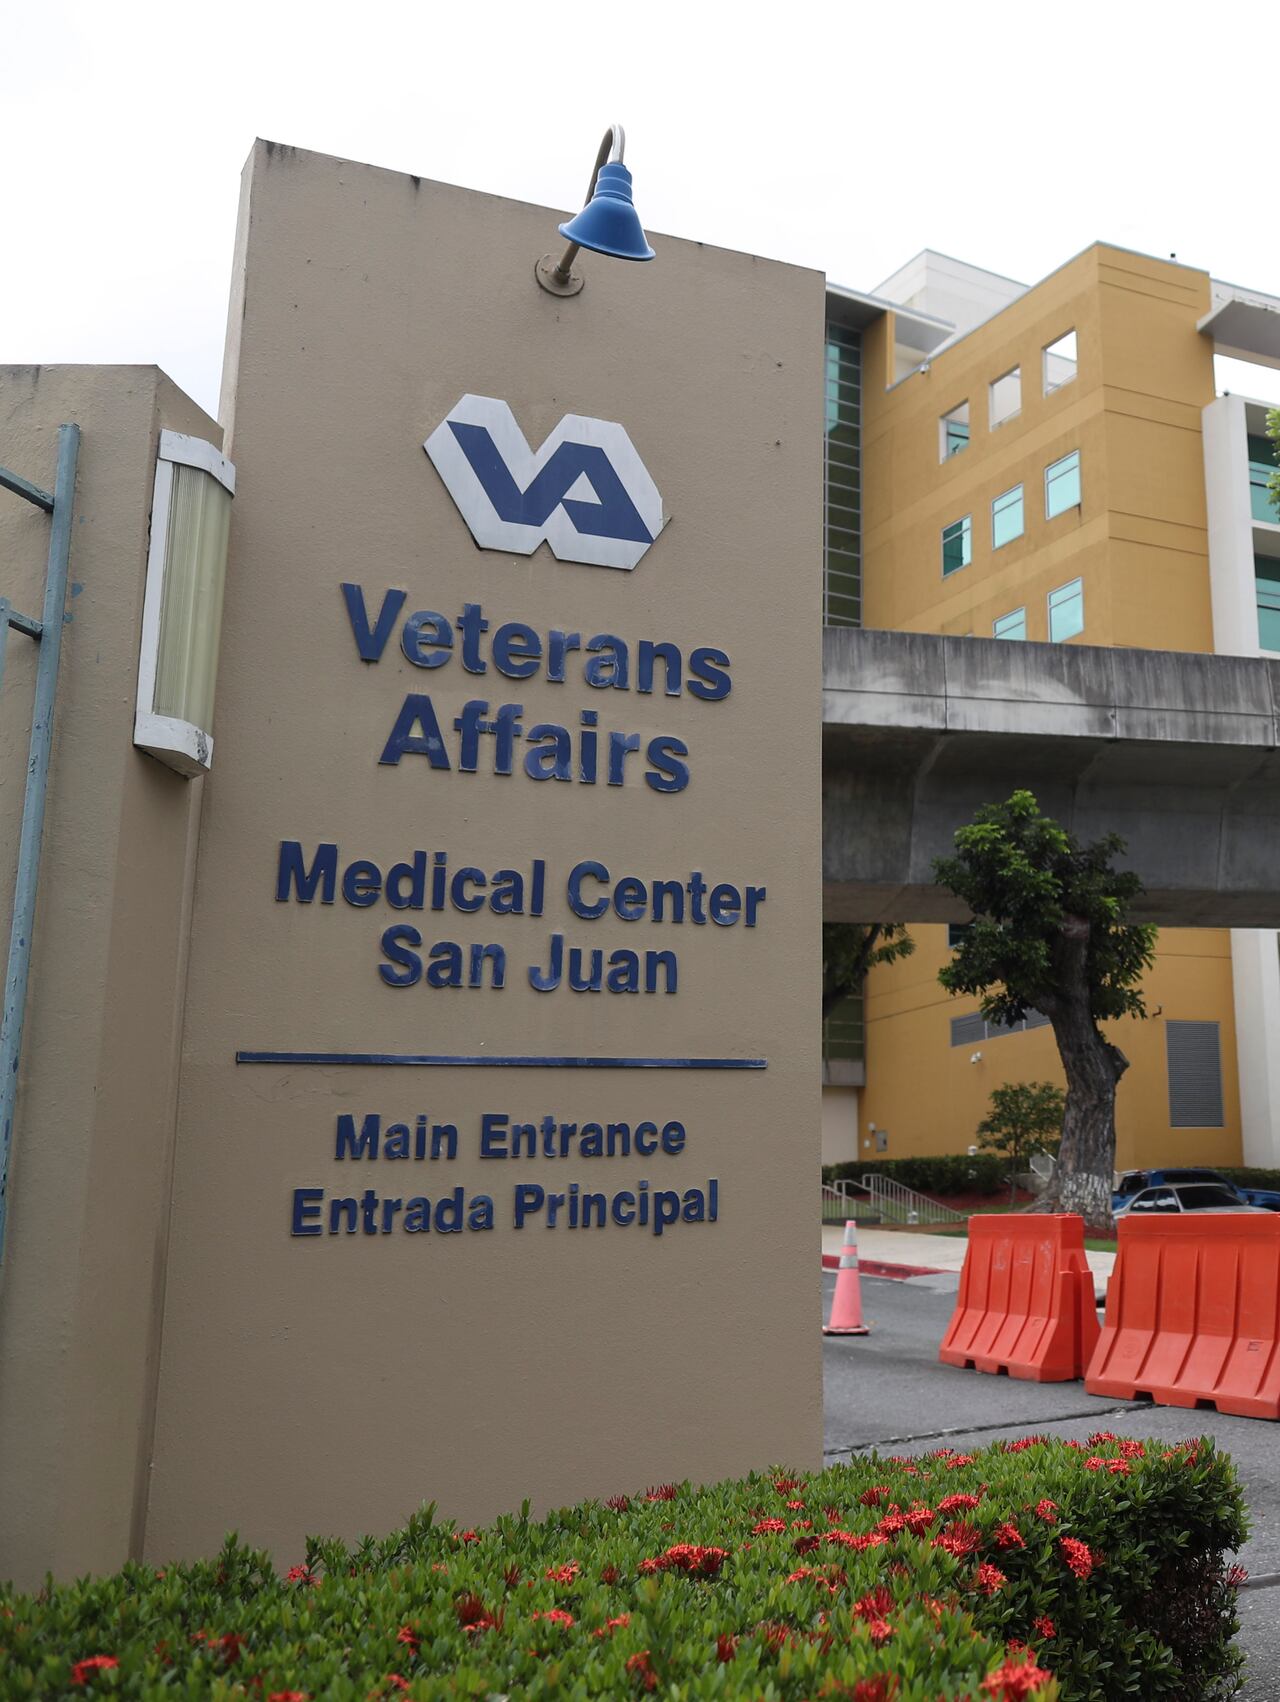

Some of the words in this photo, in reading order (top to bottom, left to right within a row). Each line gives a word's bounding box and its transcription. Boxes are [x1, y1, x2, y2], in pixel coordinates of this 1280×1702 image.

[446, 420, 655, 544] VA
[340, 582, 732, 701] Veterans
[378, 693, 690, 793] Affairs
[275, 840, 545, 917] Medical
[567, 861, 766, 927] Center
[378, 924, 507, 989] San
[528, 934, 679, 994] Juan
[334, 1114, 458, 1160] Main
[479, 1113, 687, 1158] Entrance
[290, 1187, 494, 1236] Entrada
[513, 1178, 719, 1235] Principal
